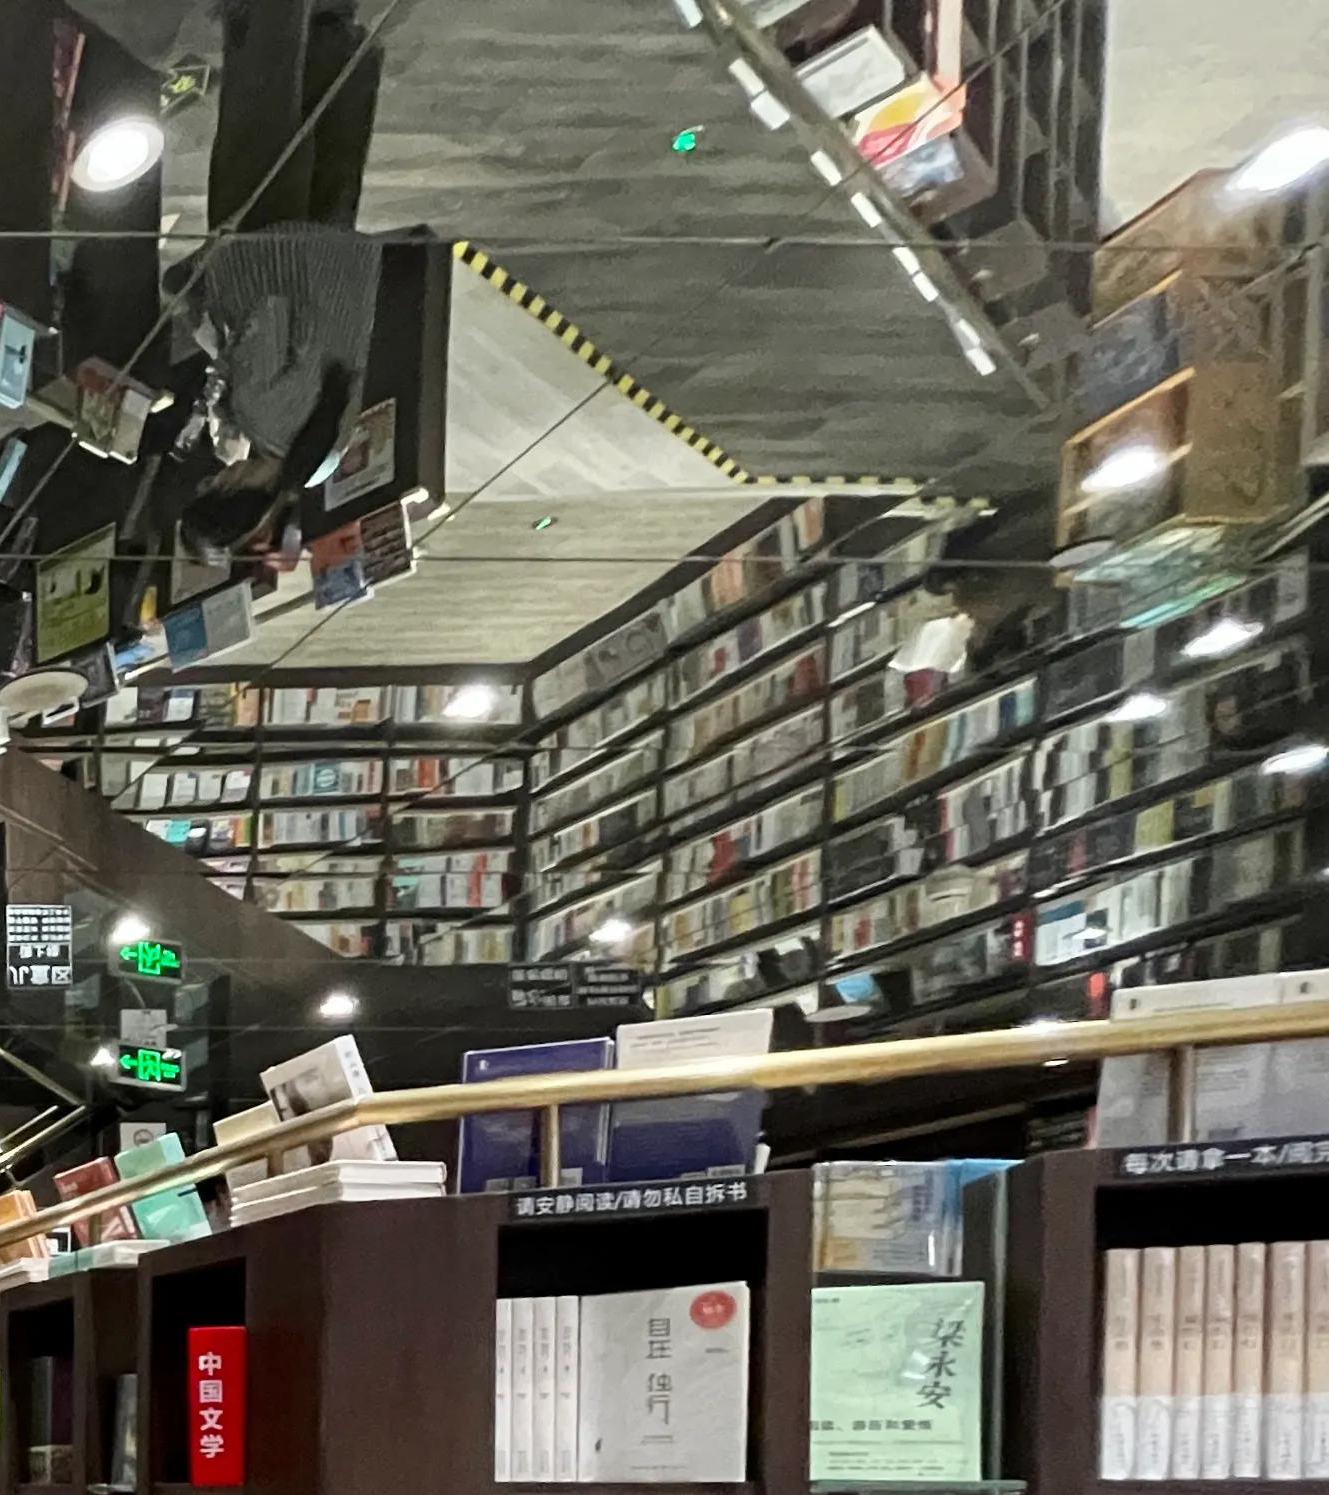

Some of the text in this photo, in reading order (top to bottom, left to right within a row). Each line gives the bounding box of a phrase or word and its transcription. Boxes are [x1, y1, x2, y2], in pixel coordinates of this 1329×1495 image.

[516, 1181, 748, 1216] 请安静阅读/请勿私自拆书
[198, 1351, 225, 1460] 中国文学
